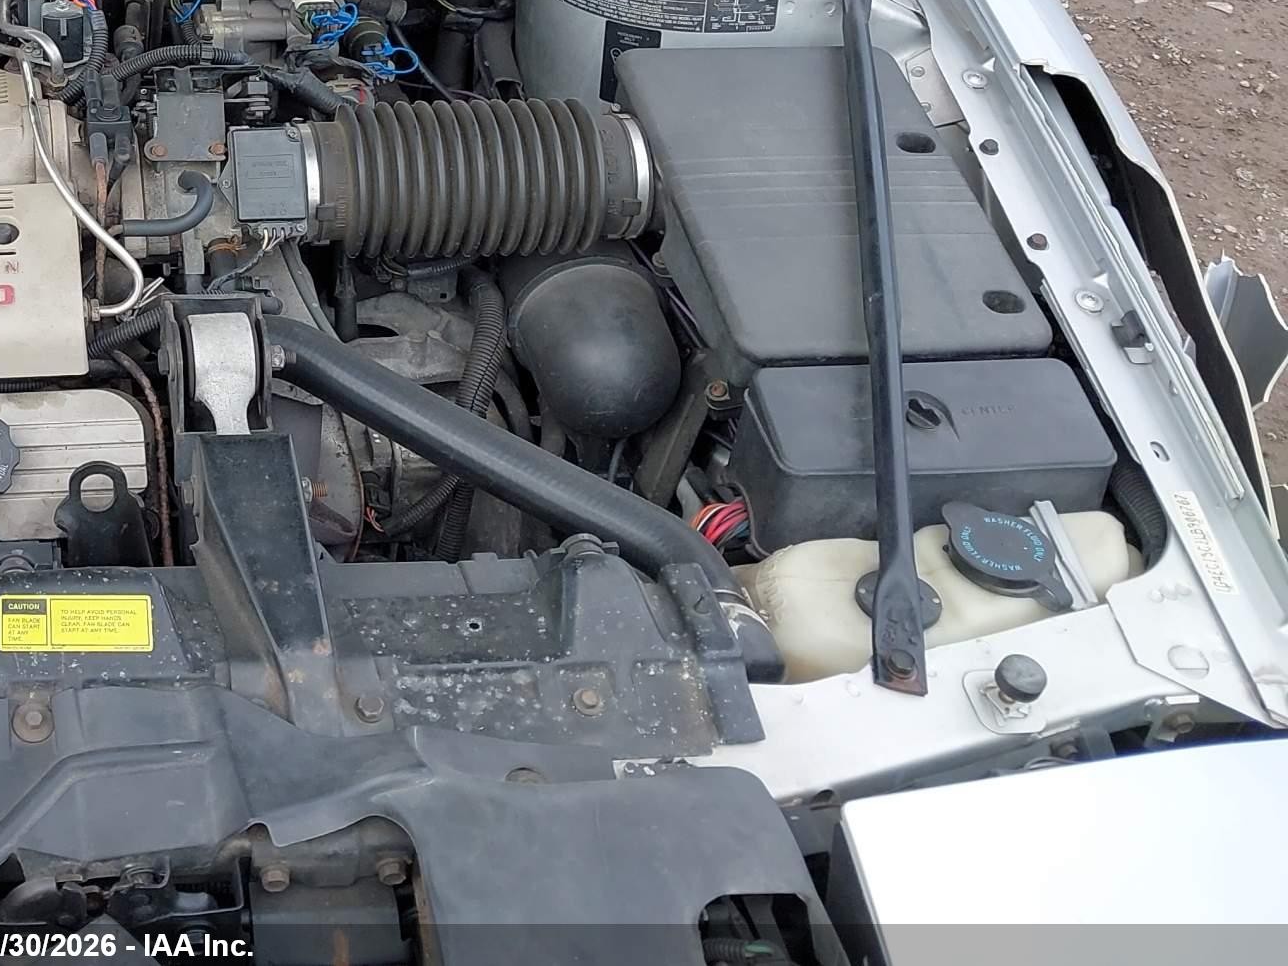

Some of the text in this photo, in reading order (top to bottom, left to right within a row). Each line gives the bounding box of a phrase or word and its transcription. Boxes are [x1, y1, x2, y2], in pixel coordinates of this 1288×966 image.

[984, 517, 1024, 530] WASHER
[981, 557, 1023, 571] WASHER
[7, 603, 40, 611] CAUTION
